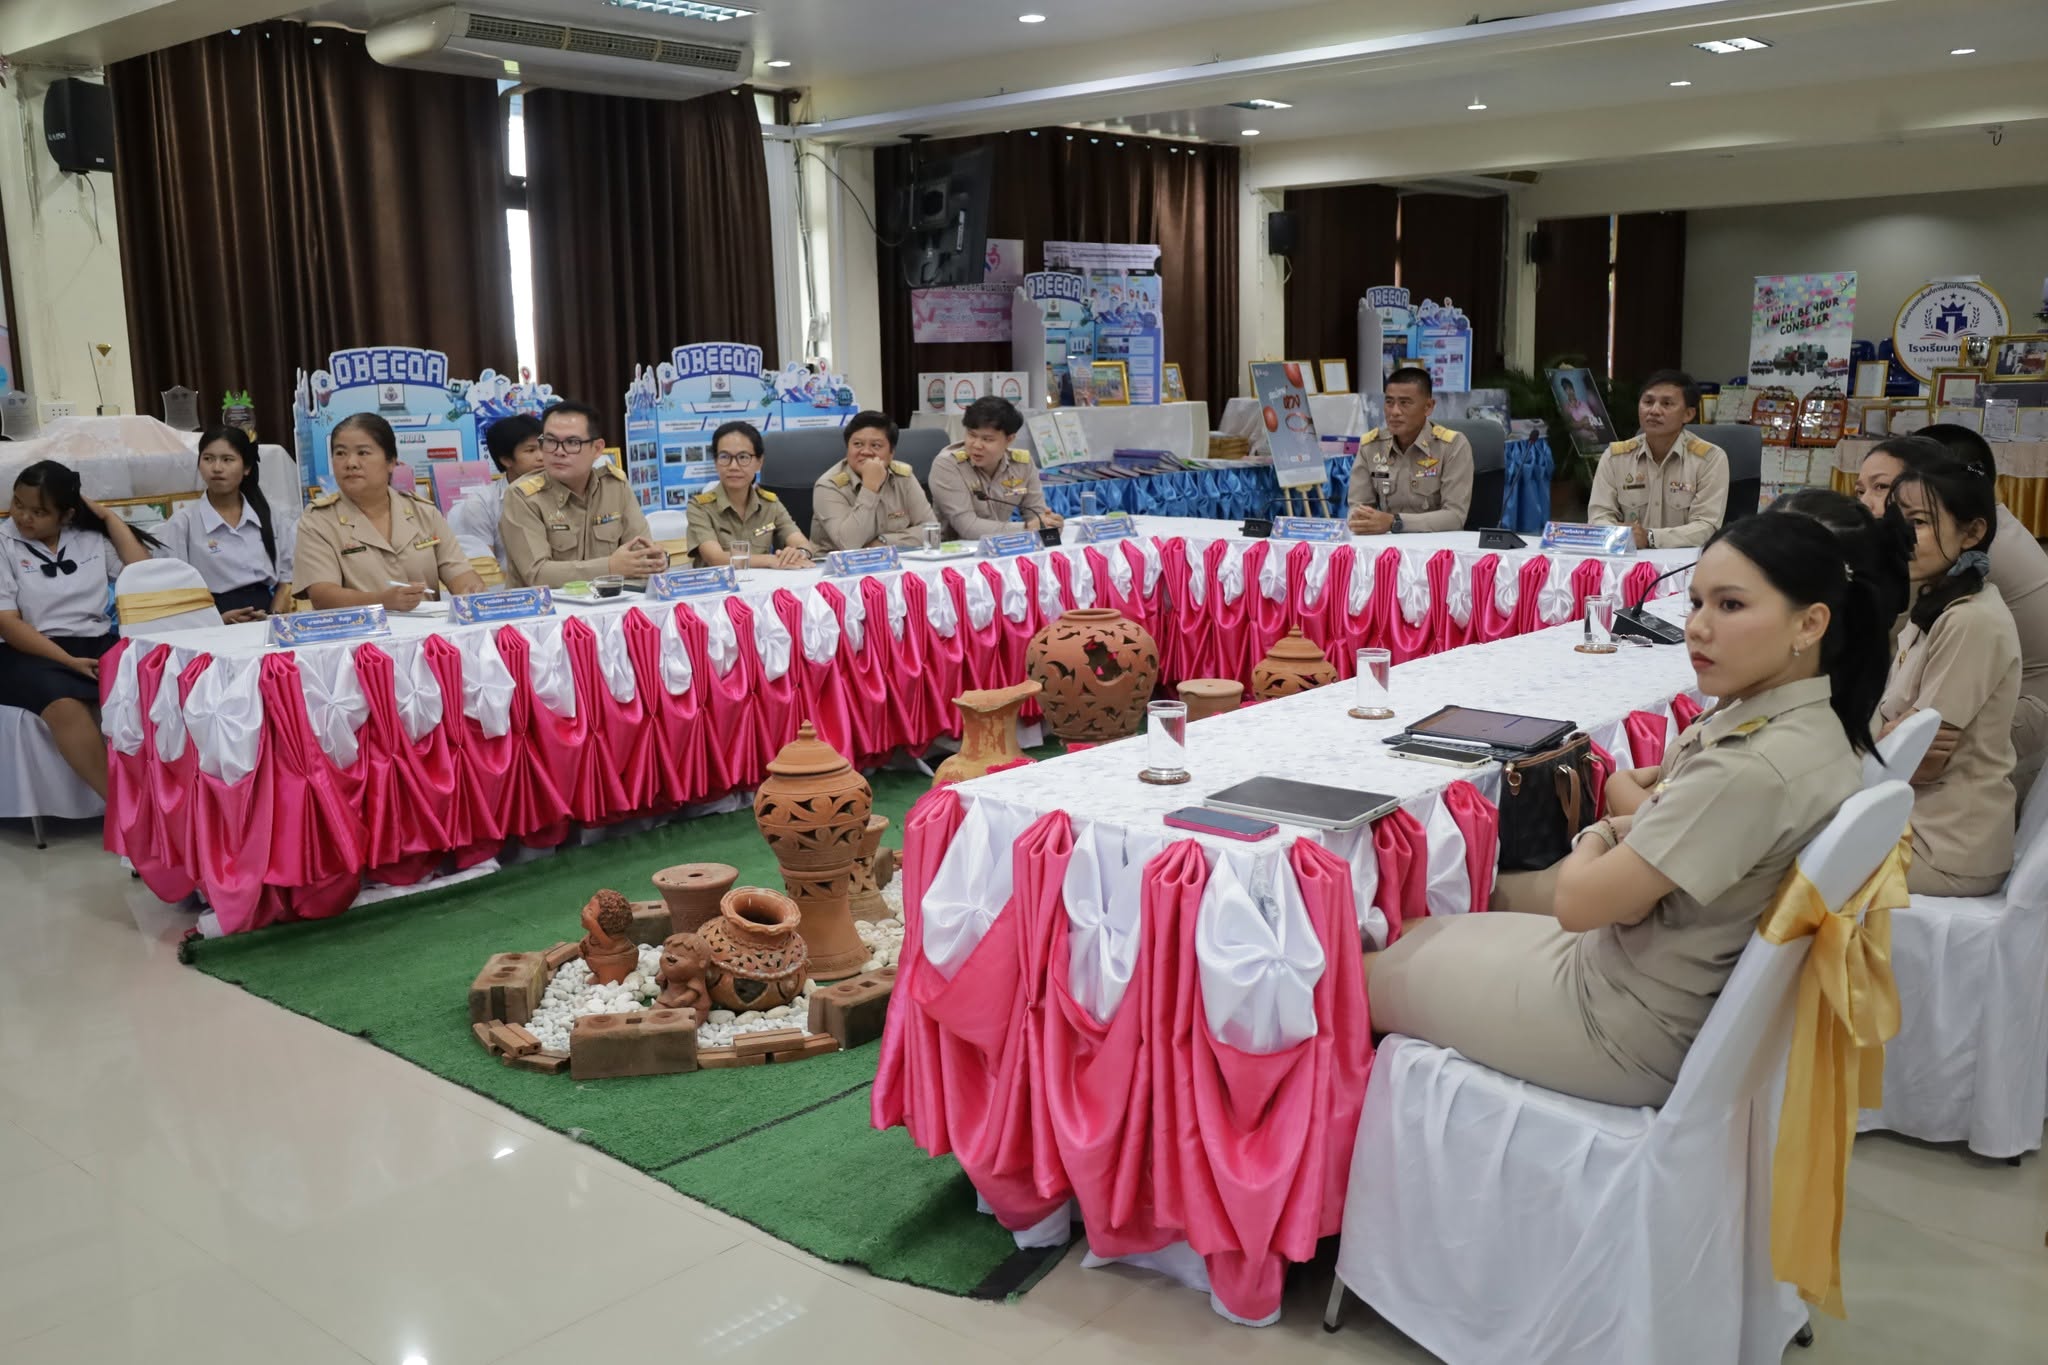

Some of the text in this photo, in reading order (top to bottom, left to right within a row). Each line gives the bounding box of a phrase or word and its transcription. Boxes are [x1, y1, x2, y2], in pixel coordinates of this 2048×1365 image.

[1772, 309, 1795, 325] WILL
[1798, 304, 1811, 317] BE
[1814, 297, 1840, 313] YOUR
[332, 351, 446, 386] OBECQA
[676, 344, 761, 377] OBECQA
